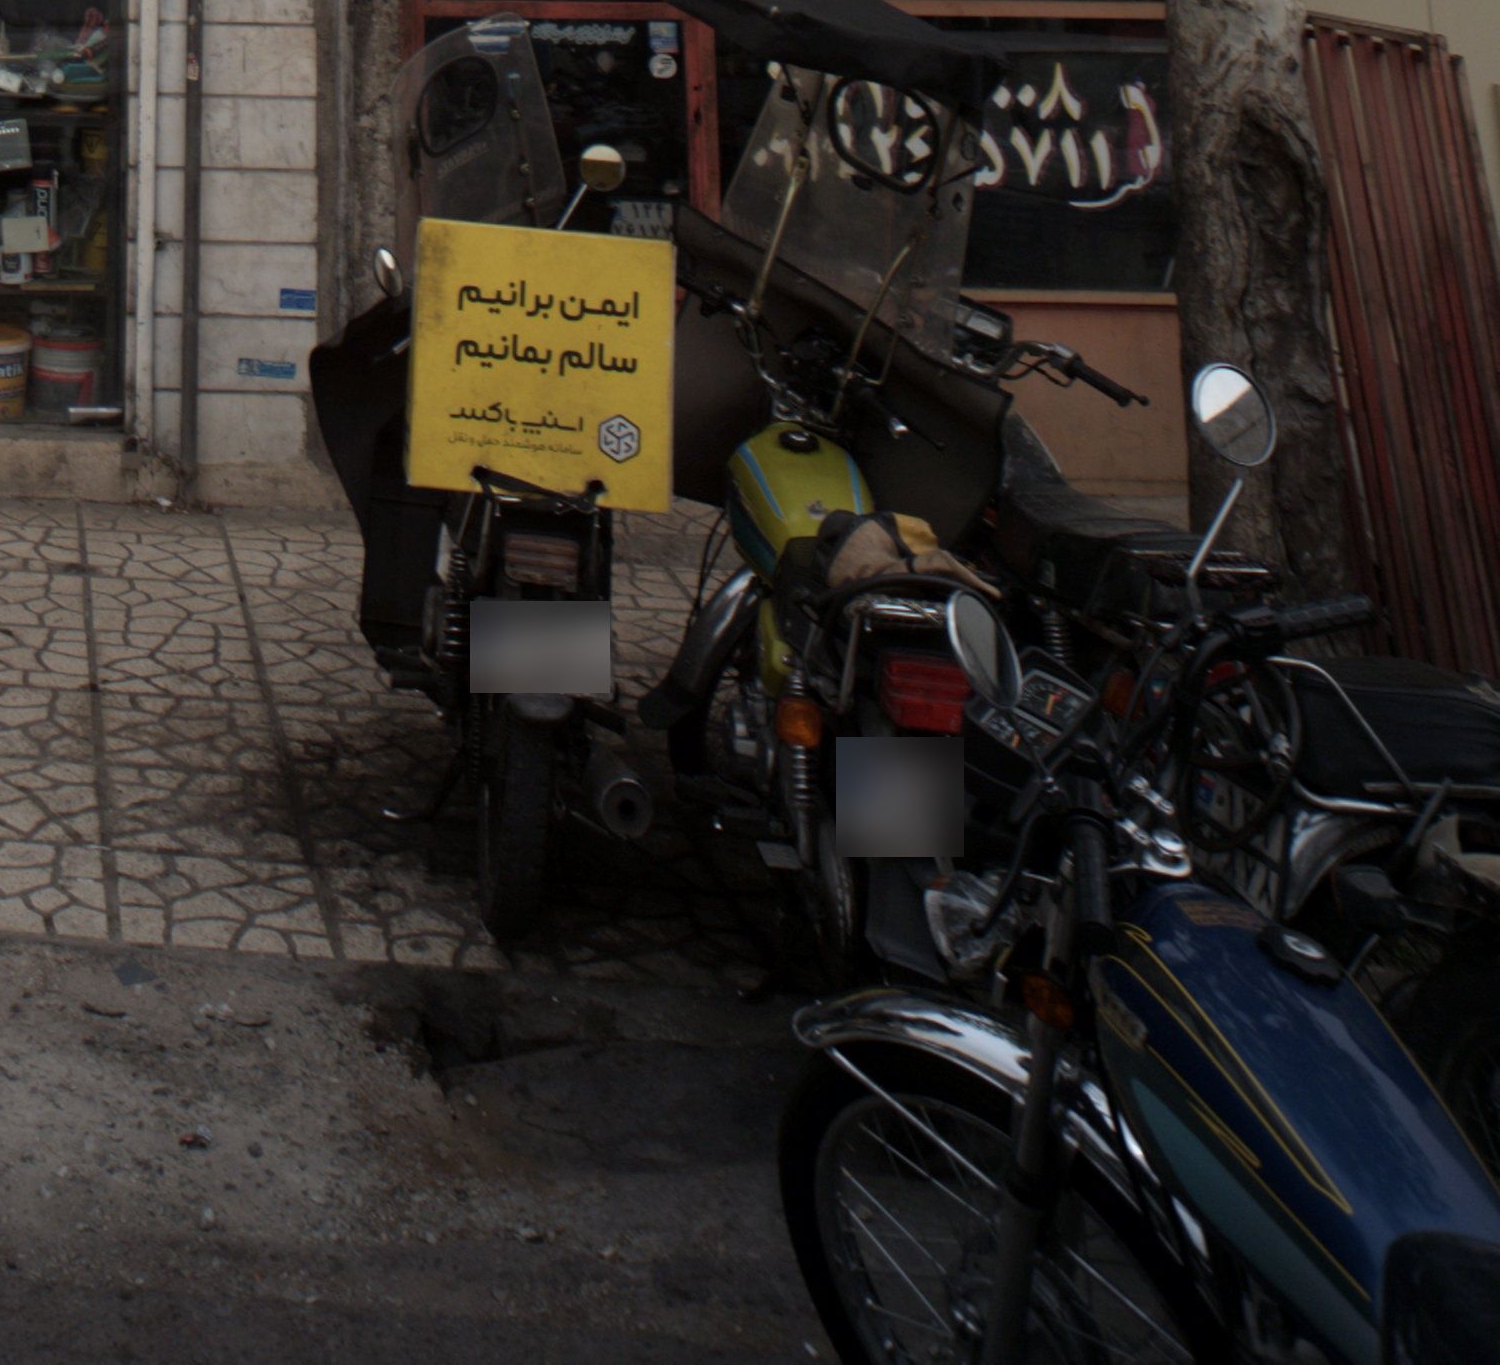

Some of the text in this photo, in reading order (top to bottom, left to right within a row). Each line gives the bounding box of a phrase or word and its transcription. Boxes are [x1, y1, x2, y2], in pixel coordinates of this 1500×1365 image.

[458, 280, 639, 327] ایمن برانیم
[455, 334, 639, 377] سالم بمانیم
